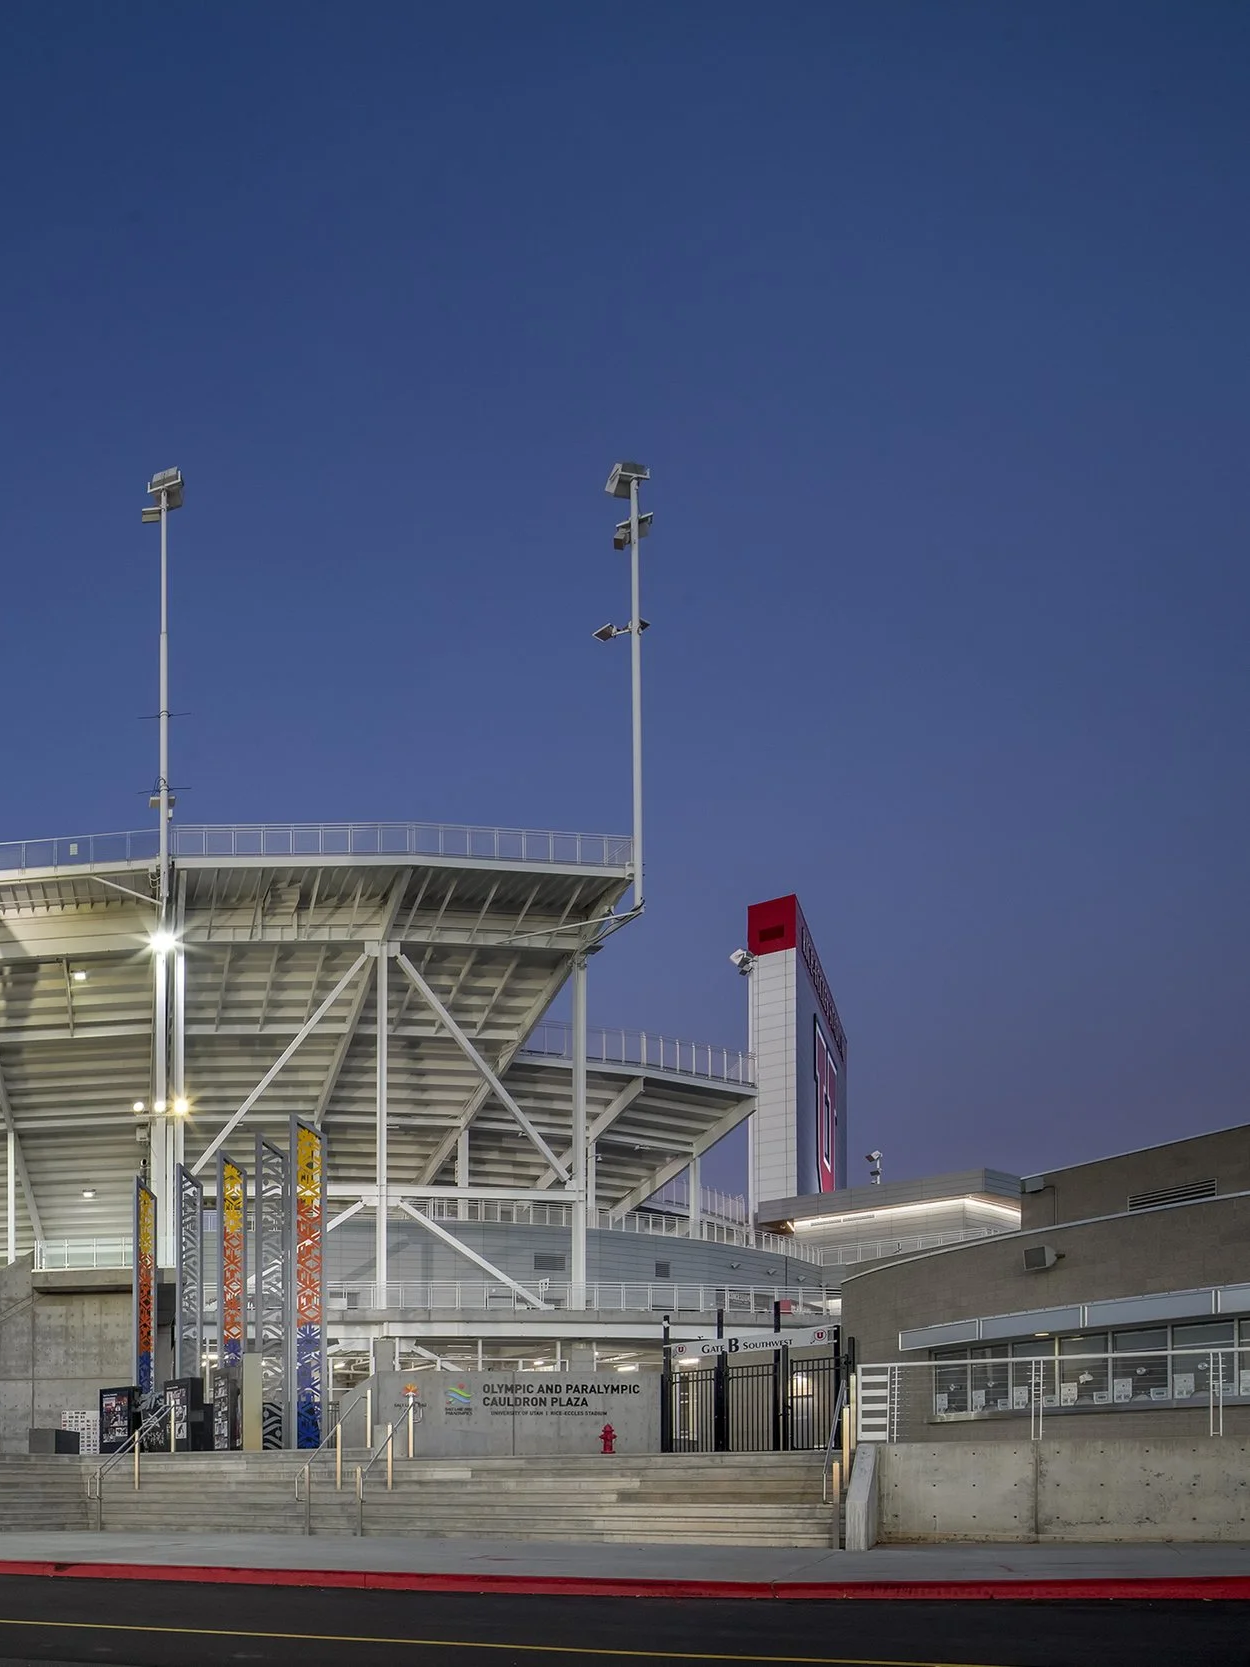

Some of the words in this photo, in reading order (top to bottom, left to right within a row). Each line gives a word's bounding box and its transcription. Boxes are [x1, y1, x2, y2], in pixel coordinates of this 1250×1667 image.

[728, 1338, 739, 1353] B
[483, 1384, 534, 1394] OLYMPIC
[537, 1384, 562, 1394] AND
[566, 1384, 640, 1394] PARALYMPIC
[483, 1397, 547, 1407] CAULDRON
[551, 1397, 589, 1407] PLAZA
